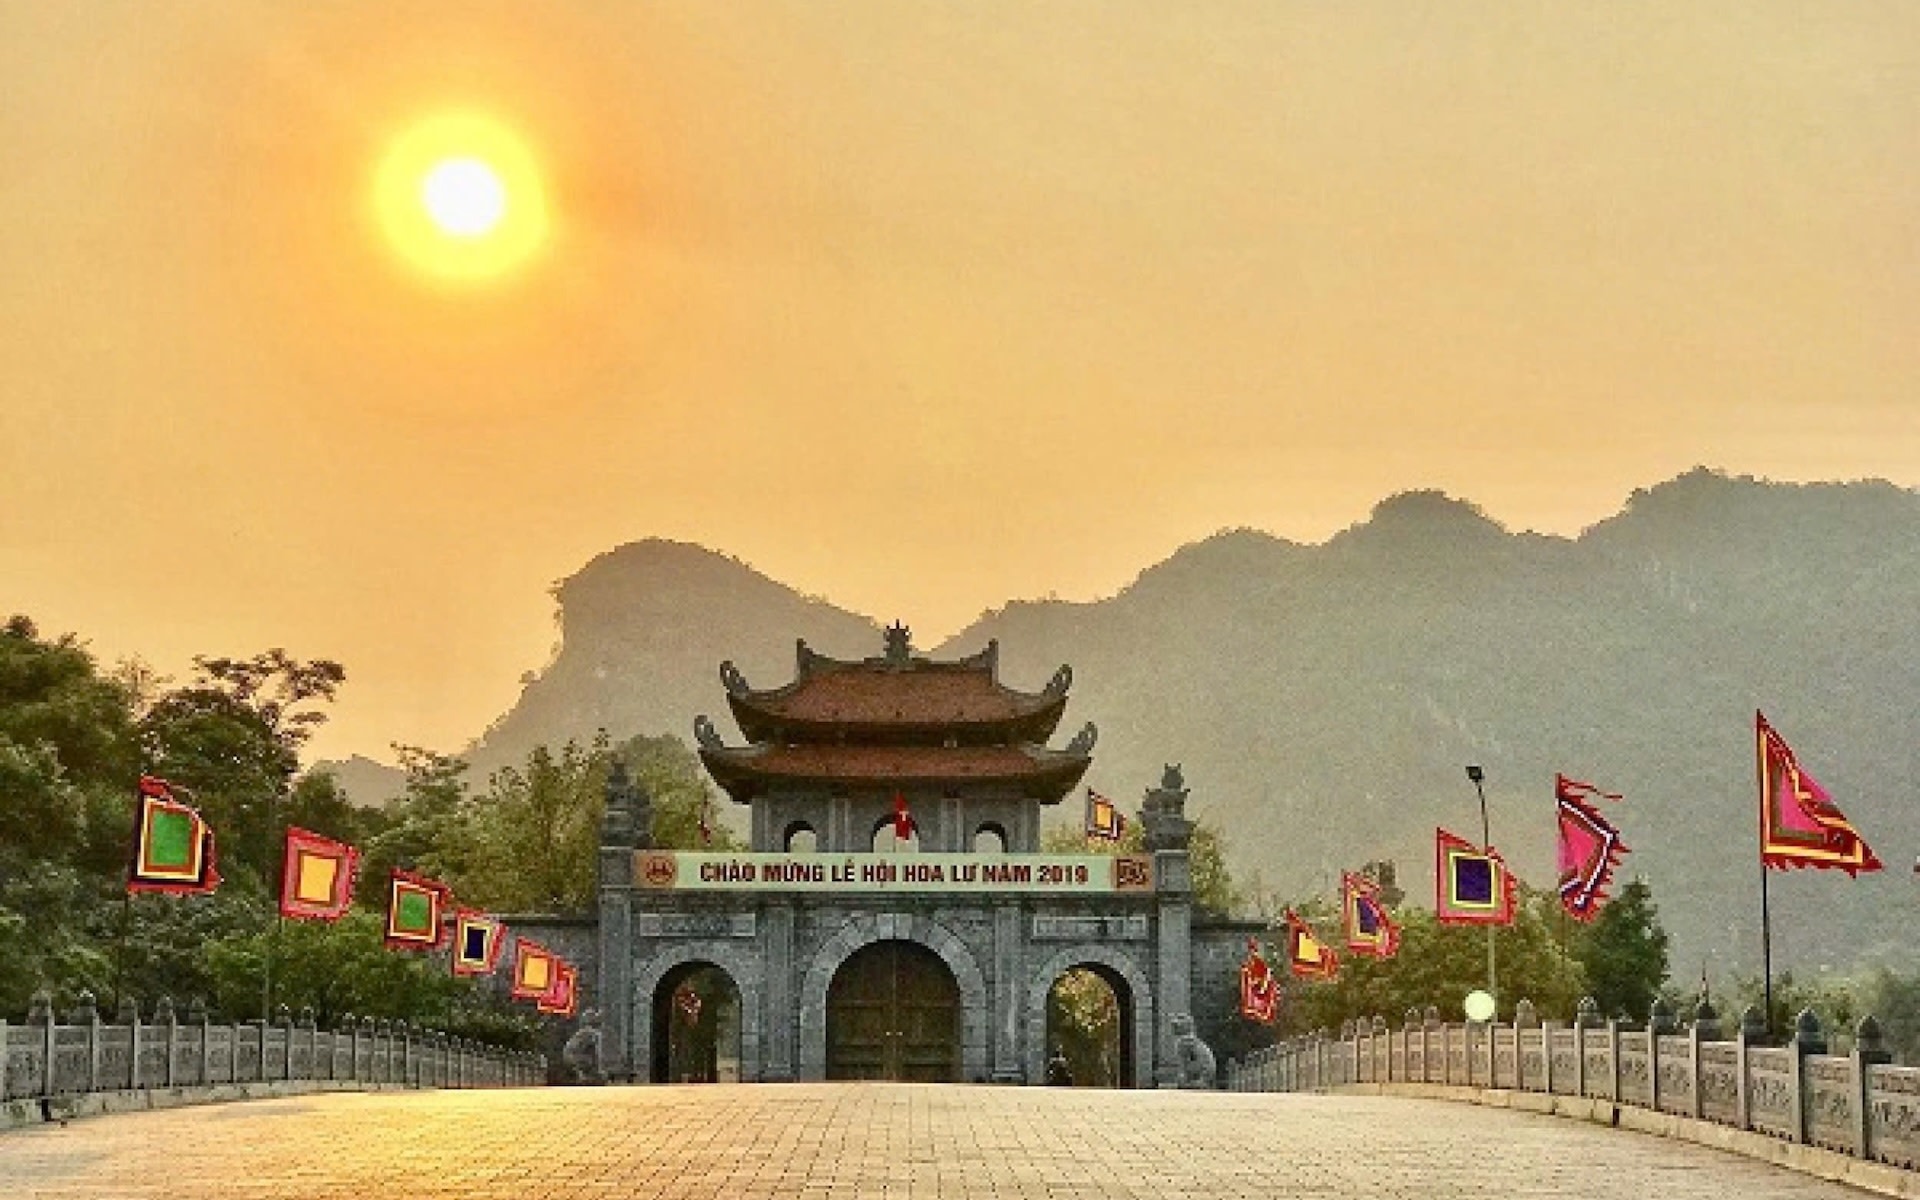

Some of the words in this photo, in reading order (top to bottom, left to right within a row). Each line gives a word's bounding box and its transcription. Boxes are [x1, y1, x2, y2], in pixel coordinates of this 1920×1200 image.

[902, 864, 945, 882] HOA
[950, 862, 980, 882] LƯ
[1036, 864, 1089, 885] 2019
